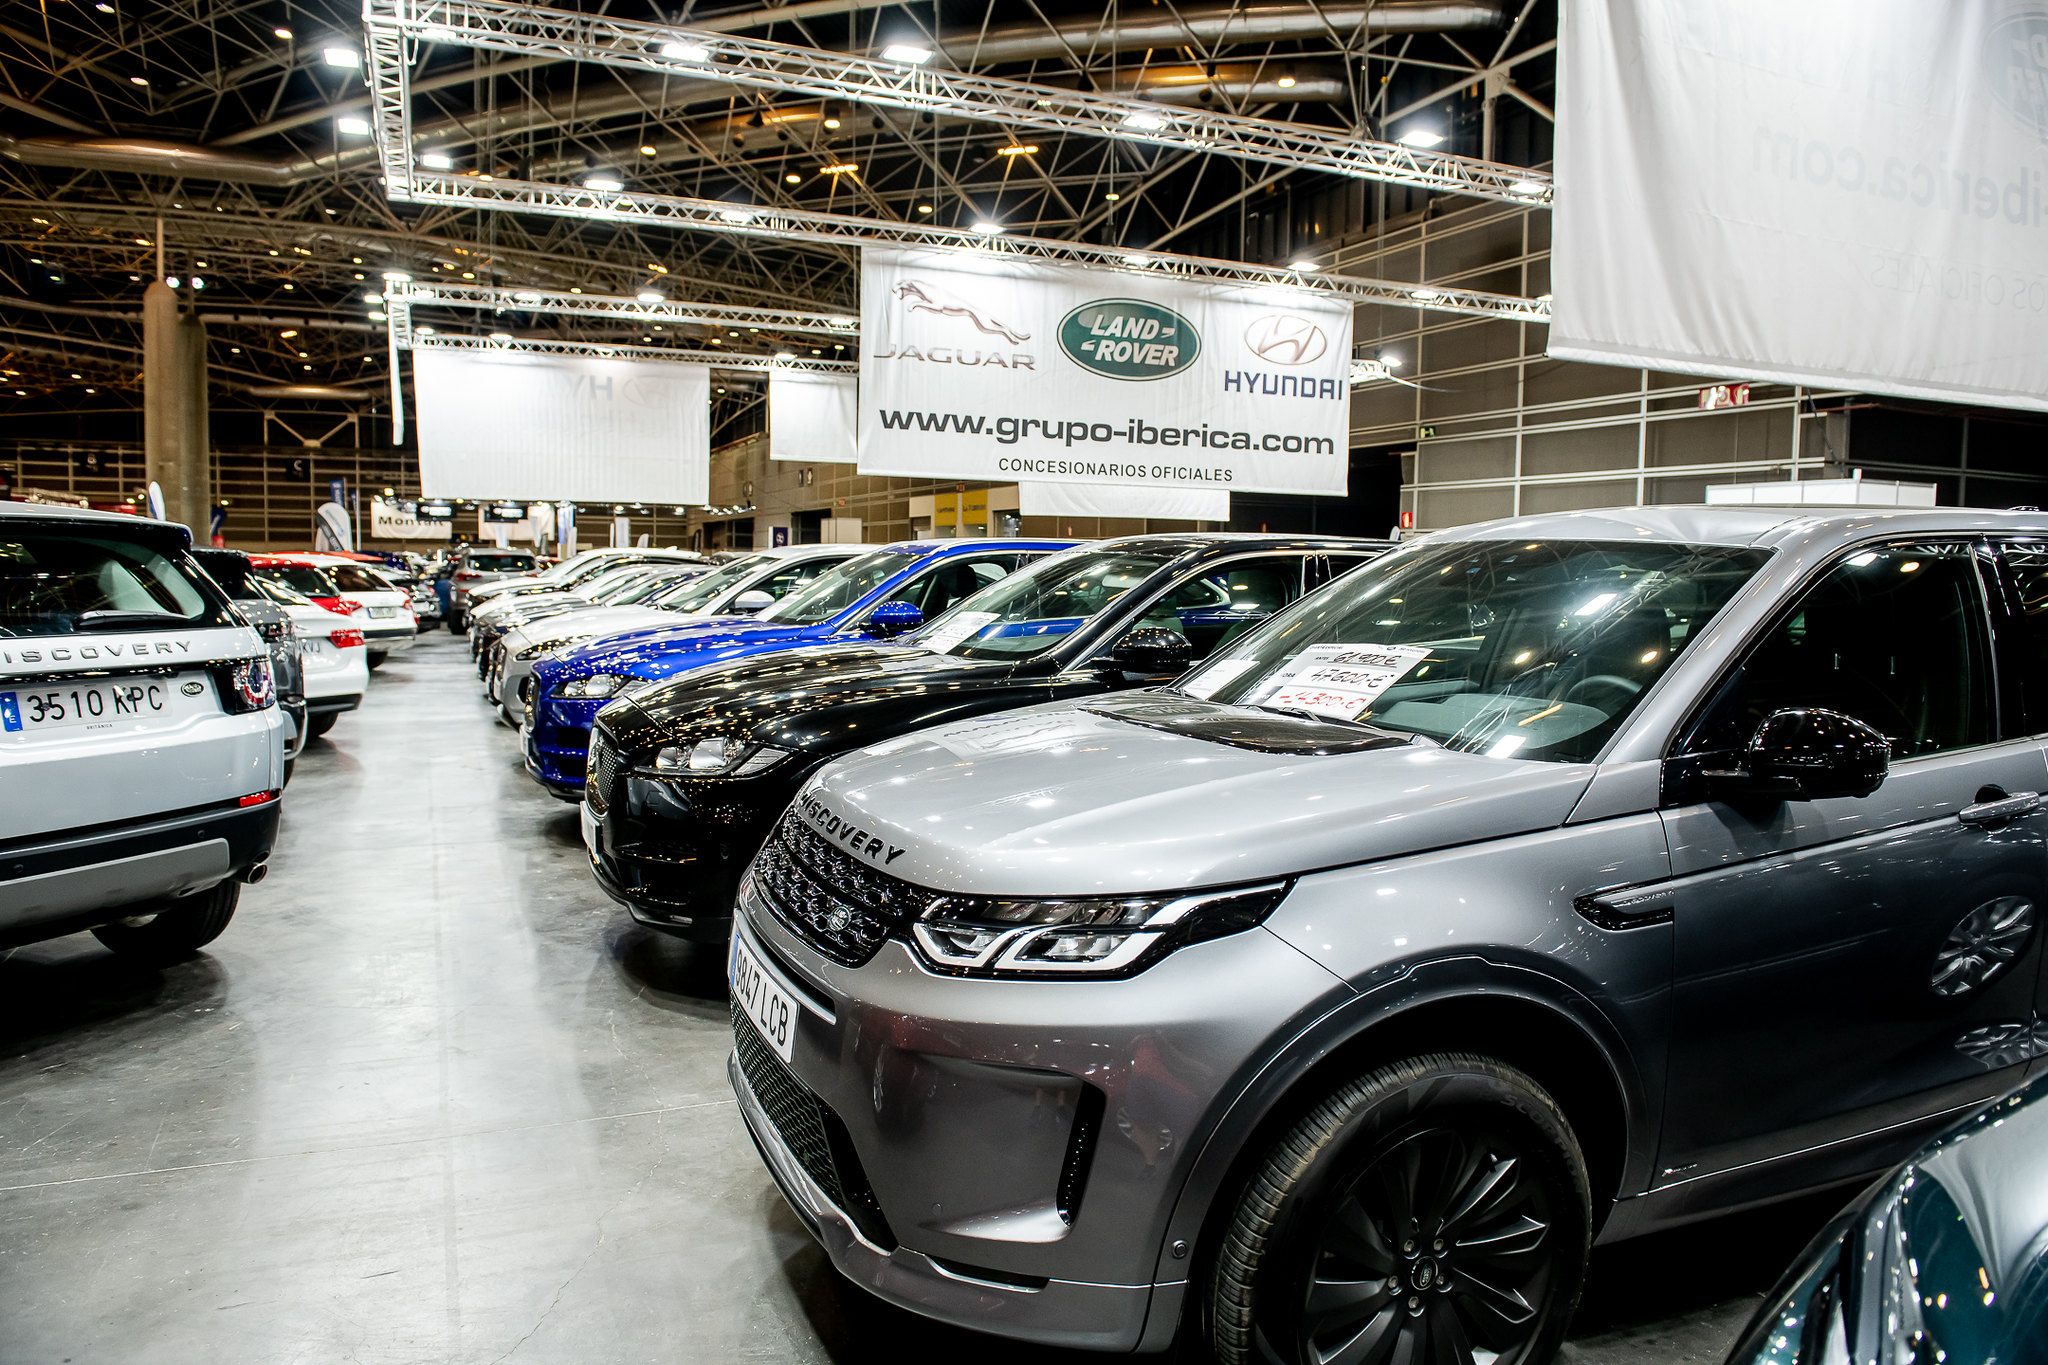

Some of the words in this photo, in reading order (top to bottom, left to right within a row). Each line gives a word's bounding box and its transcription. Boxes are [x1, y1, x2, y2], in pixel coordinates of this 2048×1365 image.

[1091, 313, 1159, 339] LAND
[874, 343, 1037, 372] JAGUAR
[1095, 338, 1180, 367] ROVER
[1224, 370, 1343, 400] HYUNDAI
[879, 409, 1335, 455] www.grupo-iberica.com
[998, 457, 1147, 478] CONCESIONARIOS
[1151, 466, 1234, 482] OFICIALES
[27, 689, 104, 722] 3510
[113, 685, 163, 715] KPC
[736, 949, 761, 1009] 9847
[760, 982, 789, 1047] LCB
